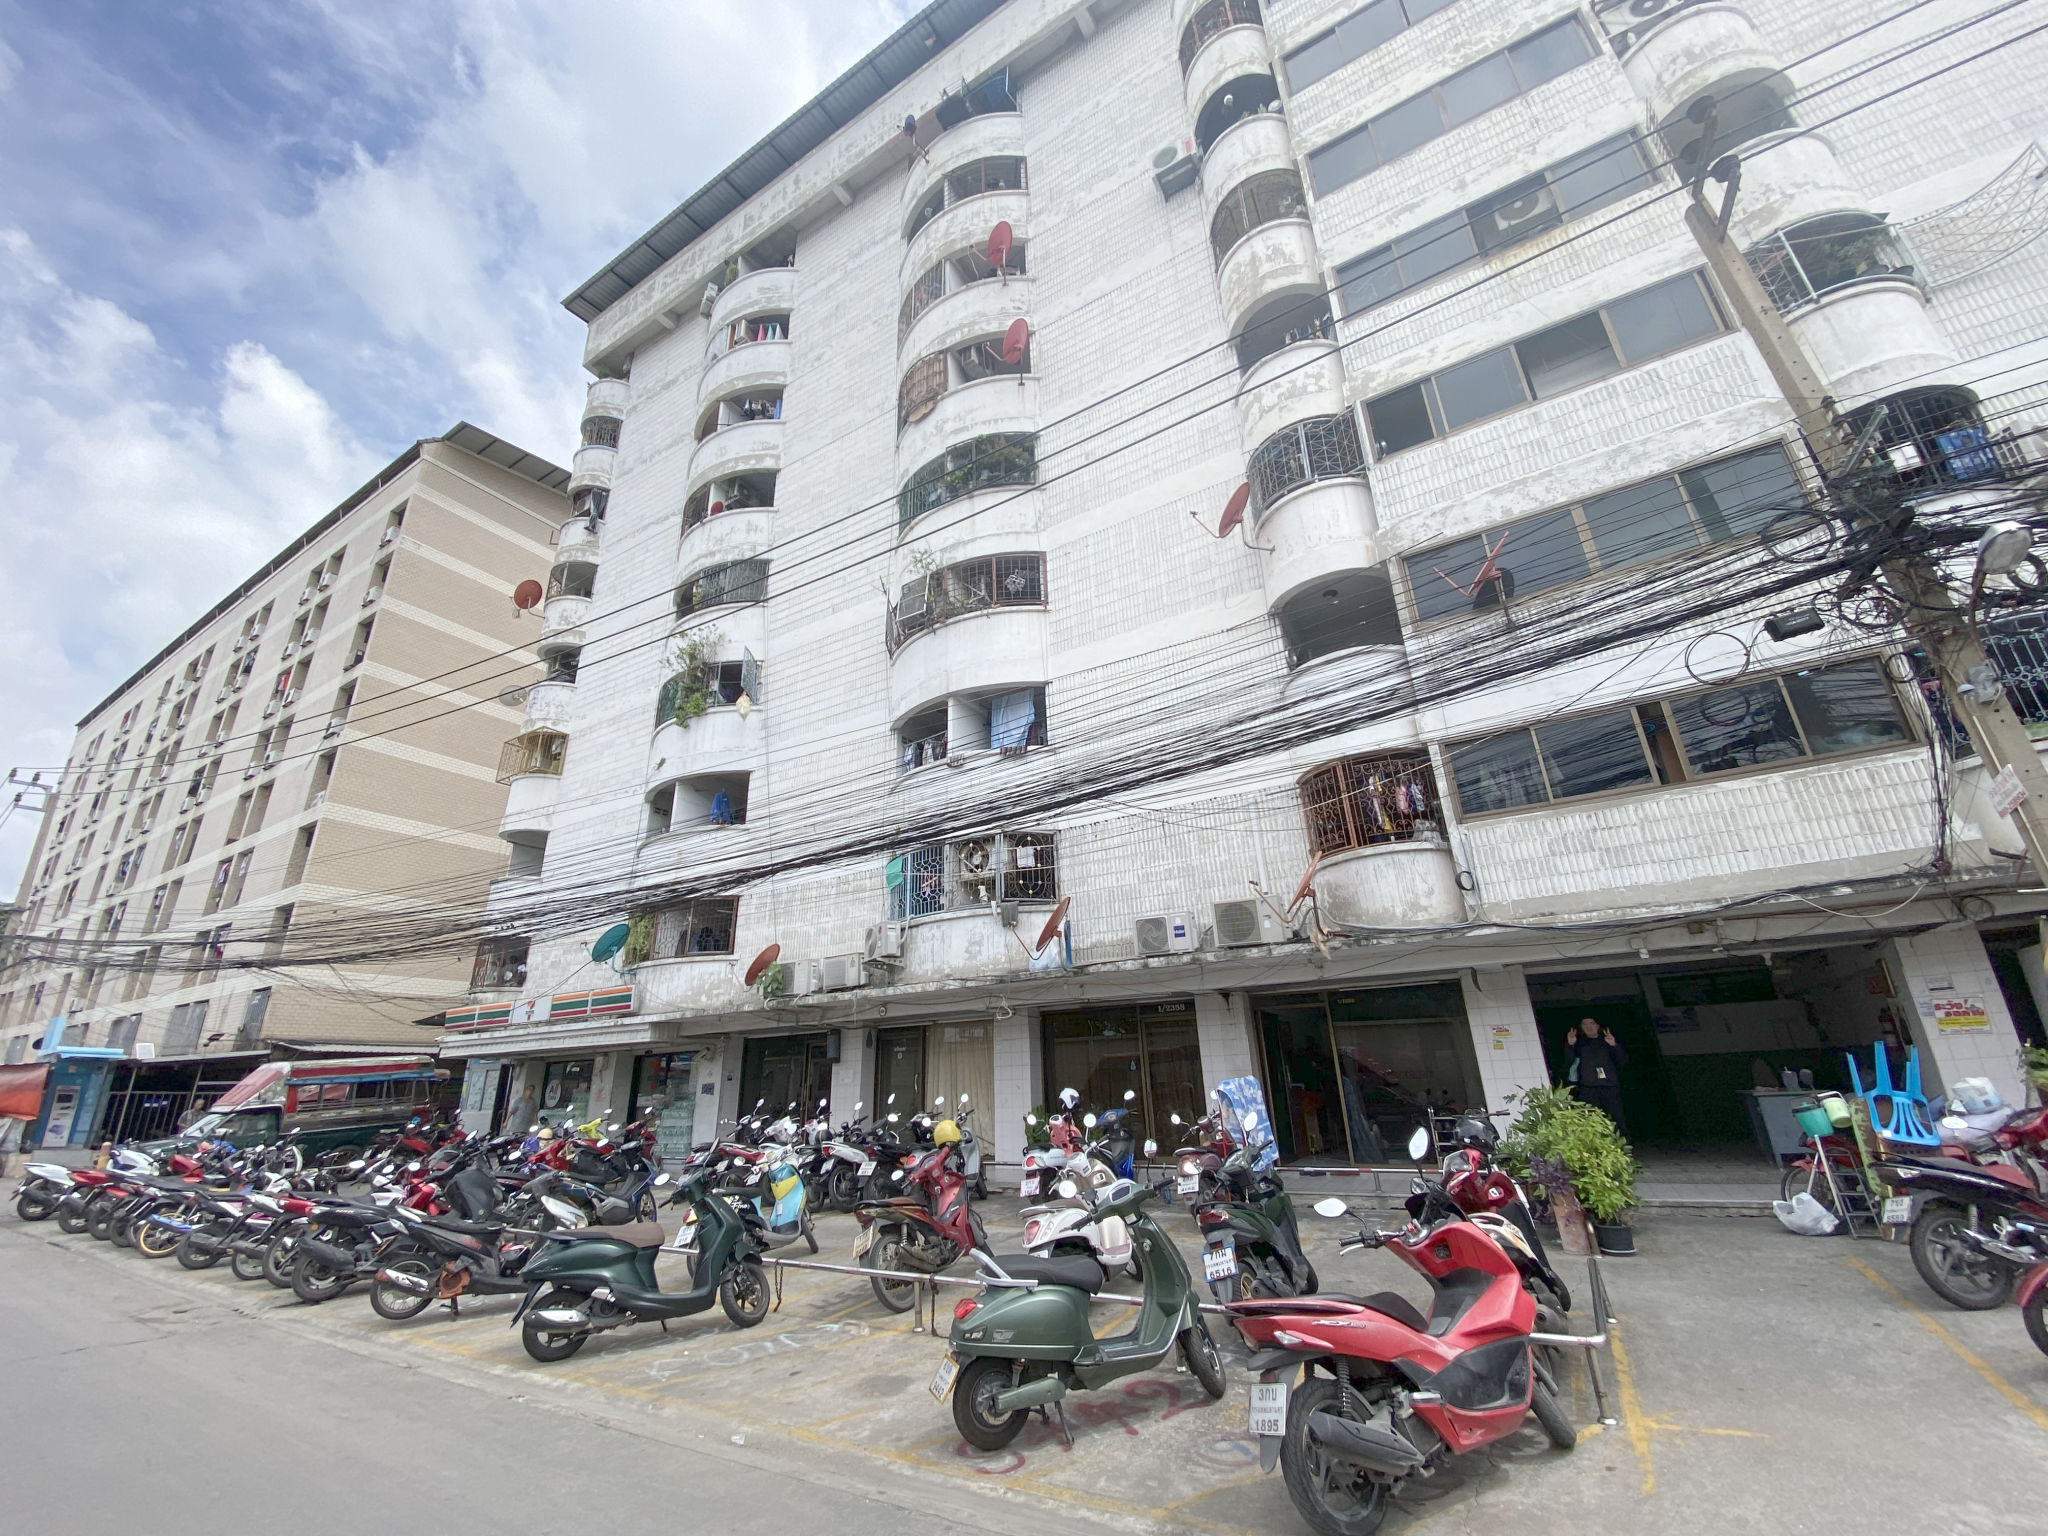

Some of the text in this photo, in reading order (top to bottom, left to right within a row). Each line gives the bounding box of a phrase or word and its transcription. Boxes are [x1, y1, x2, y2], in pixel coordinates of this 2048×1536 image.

[1209, 1267, 1233, 1279] 6516
[1258, 1388, 1278, 1401] 3กบ
[1256, 1419, 1280, 1432] 1895
